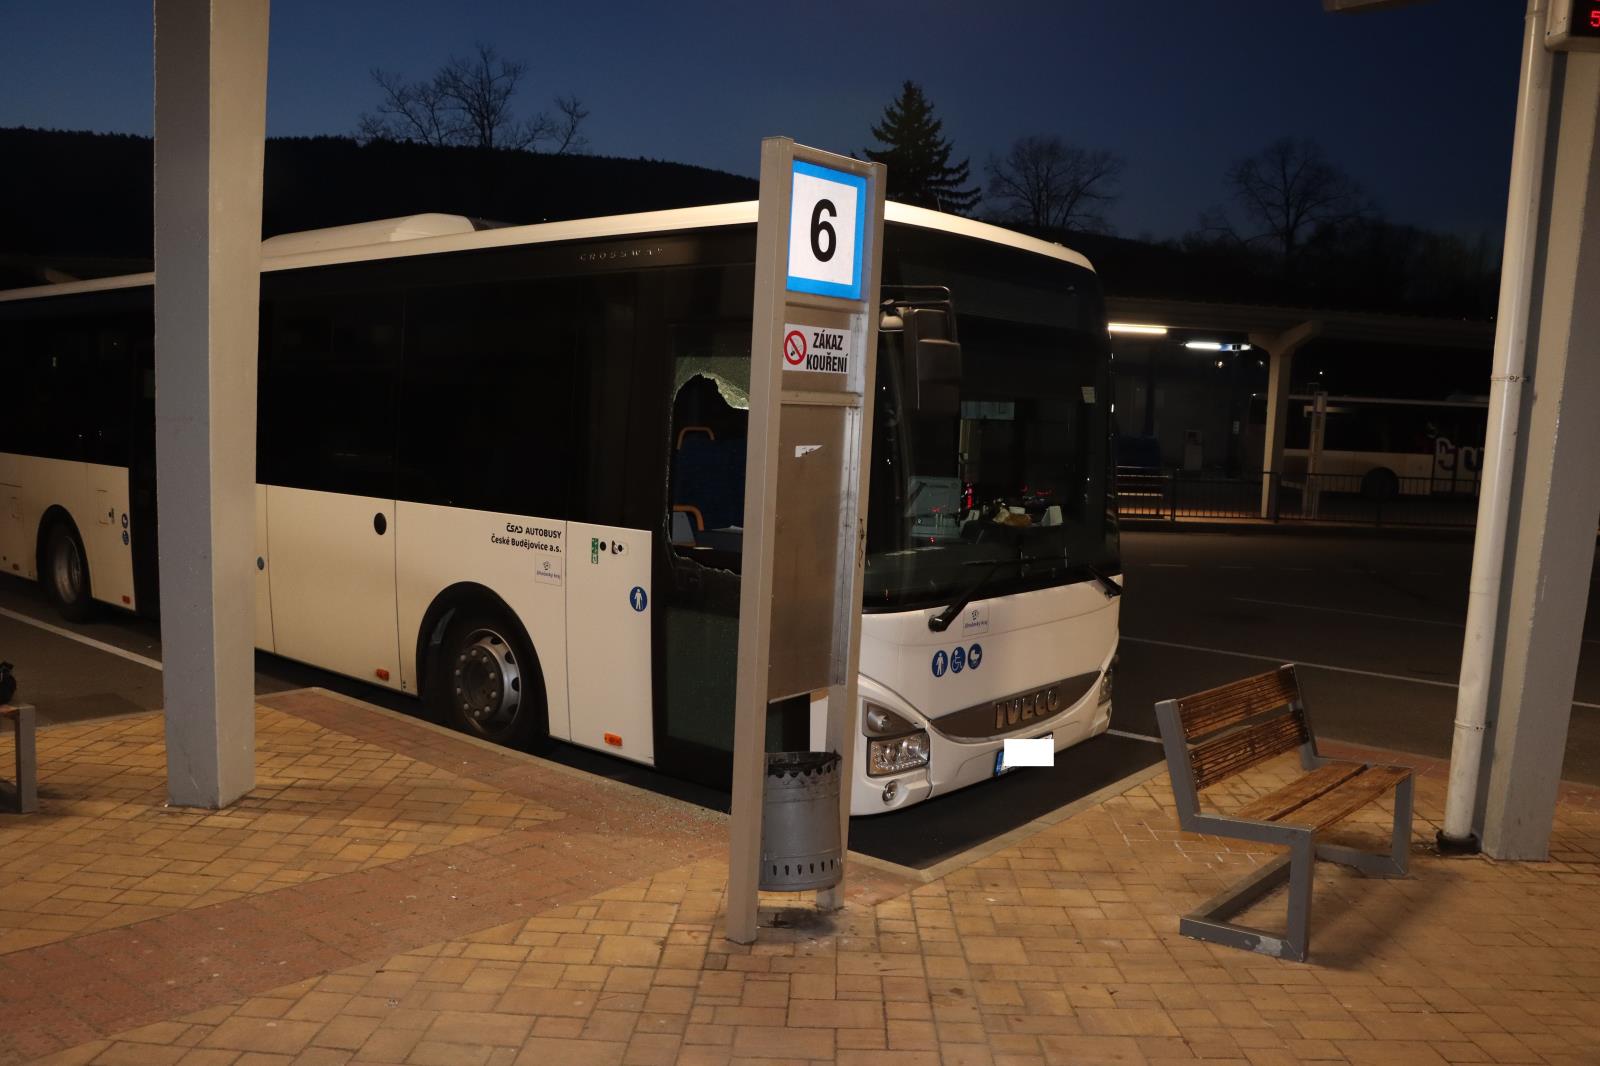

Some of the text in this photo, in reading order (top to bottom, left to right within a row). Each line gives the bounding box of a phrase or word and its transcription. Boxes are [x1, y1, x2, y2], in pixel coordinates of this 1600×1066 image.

[810, 199, 837, 262] 6
[812, 330, 843, 350] ZÁKAZ
[806, 352, 848, 372] KOUŘENÍ
[525, 527, 562, 538] AUTOBUSY
[491, 533, 562, 553] České Budějovice a.s.
[994, 688, 1057, 728] IVECO
